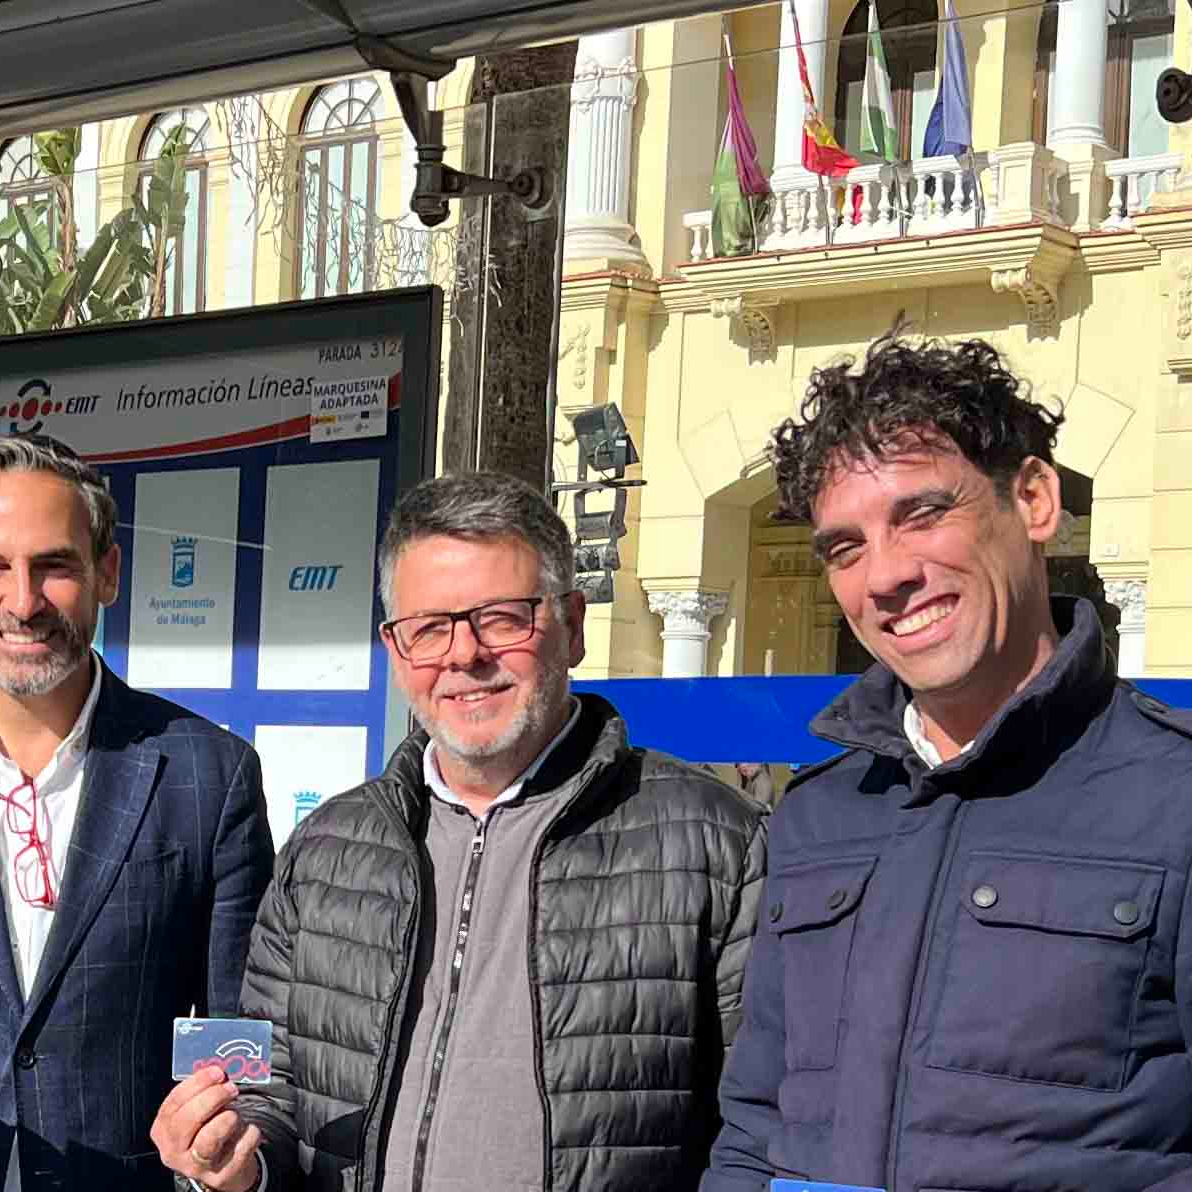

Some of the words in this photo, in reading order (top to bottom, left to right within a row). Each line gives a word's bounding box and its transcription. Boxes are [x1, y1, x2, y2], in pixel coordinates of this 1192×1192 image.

[318, 343, 362, 362] PARADA
[116, 377, 241, 411] Información
[248, 373, 315, 401] Líneas
[313, 378, 386, 398] MARQUESINA
[65, 394, 102, 415] EMT
[320, 392, 378, 409] ADAPTADA
[288, 564, 344, 591] EMT
[148, 596, 216, 611] Ayuntamiento
[169, 612, 206, 628] Málaga
